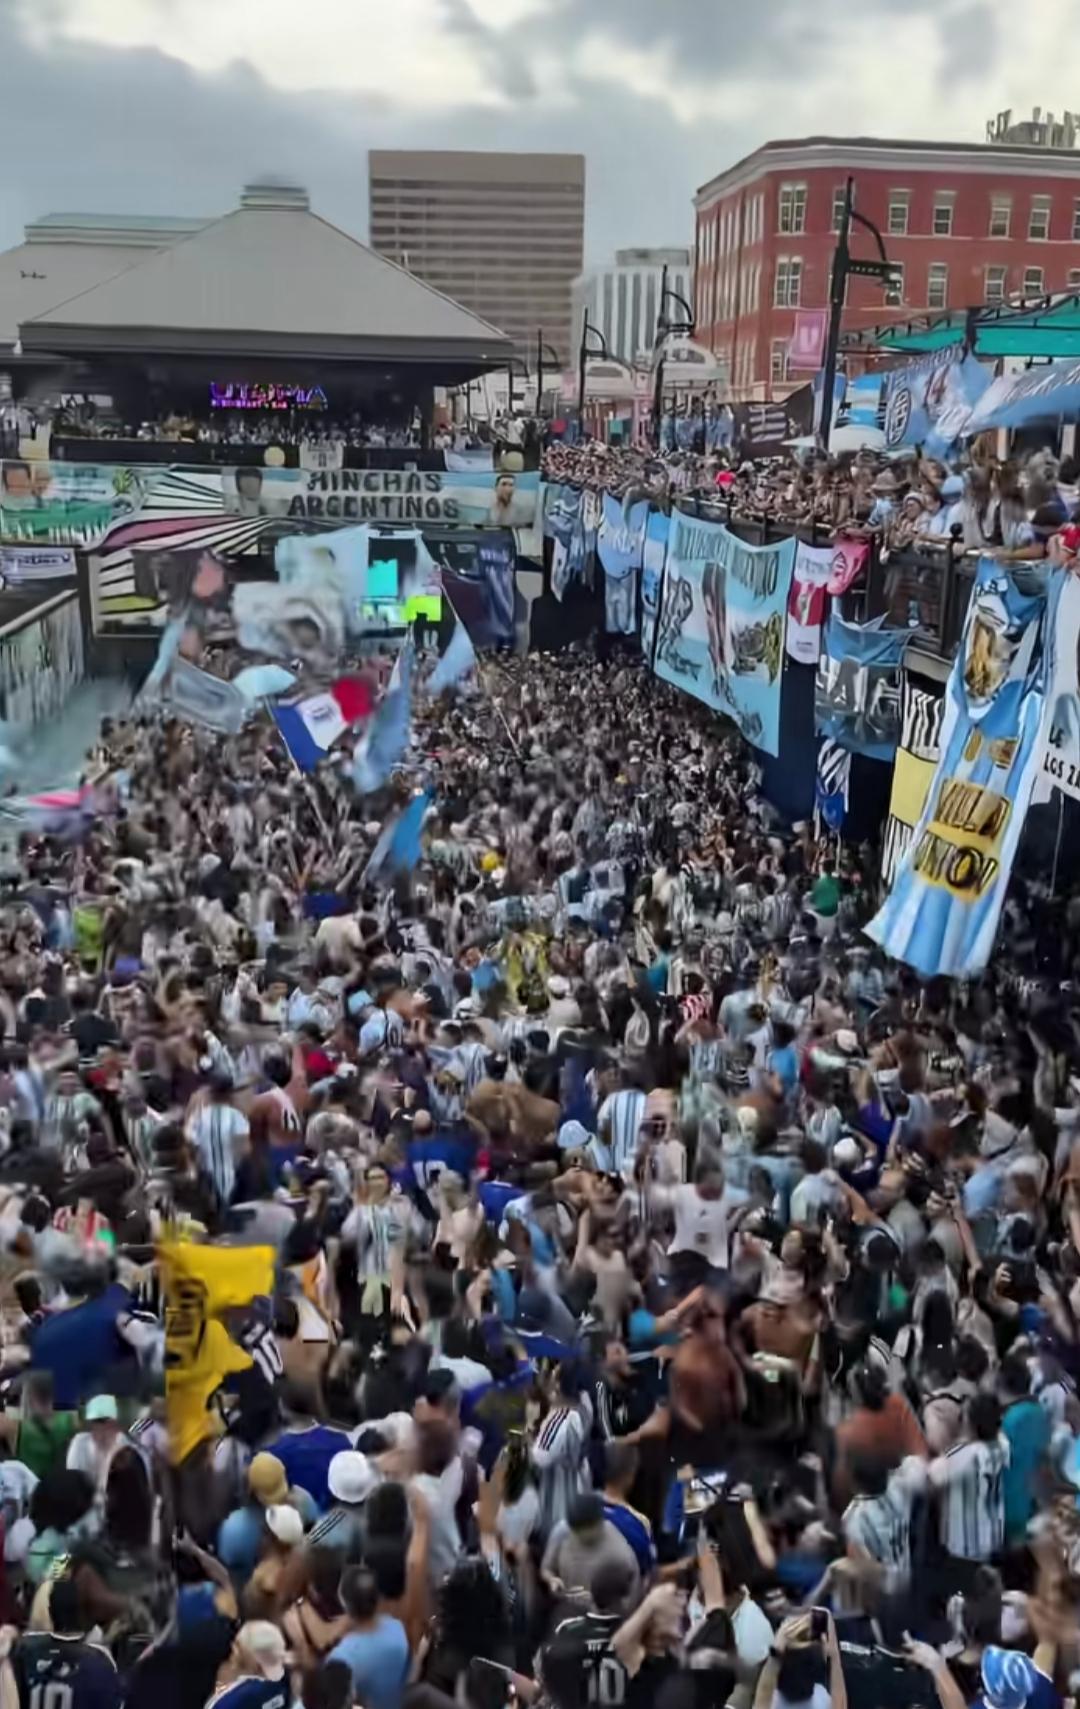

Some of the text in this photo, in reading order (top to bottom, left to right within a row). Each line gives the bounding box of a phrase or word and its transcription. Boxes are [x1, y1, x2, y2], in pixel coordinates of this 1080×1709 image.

[307, 470, 442, 493] HINCHAS
[287, 494, 460, 520] ARGENTINOS
[252, 1329, 284, 1385] 10
[582, 1657, 625, 1706] 10
